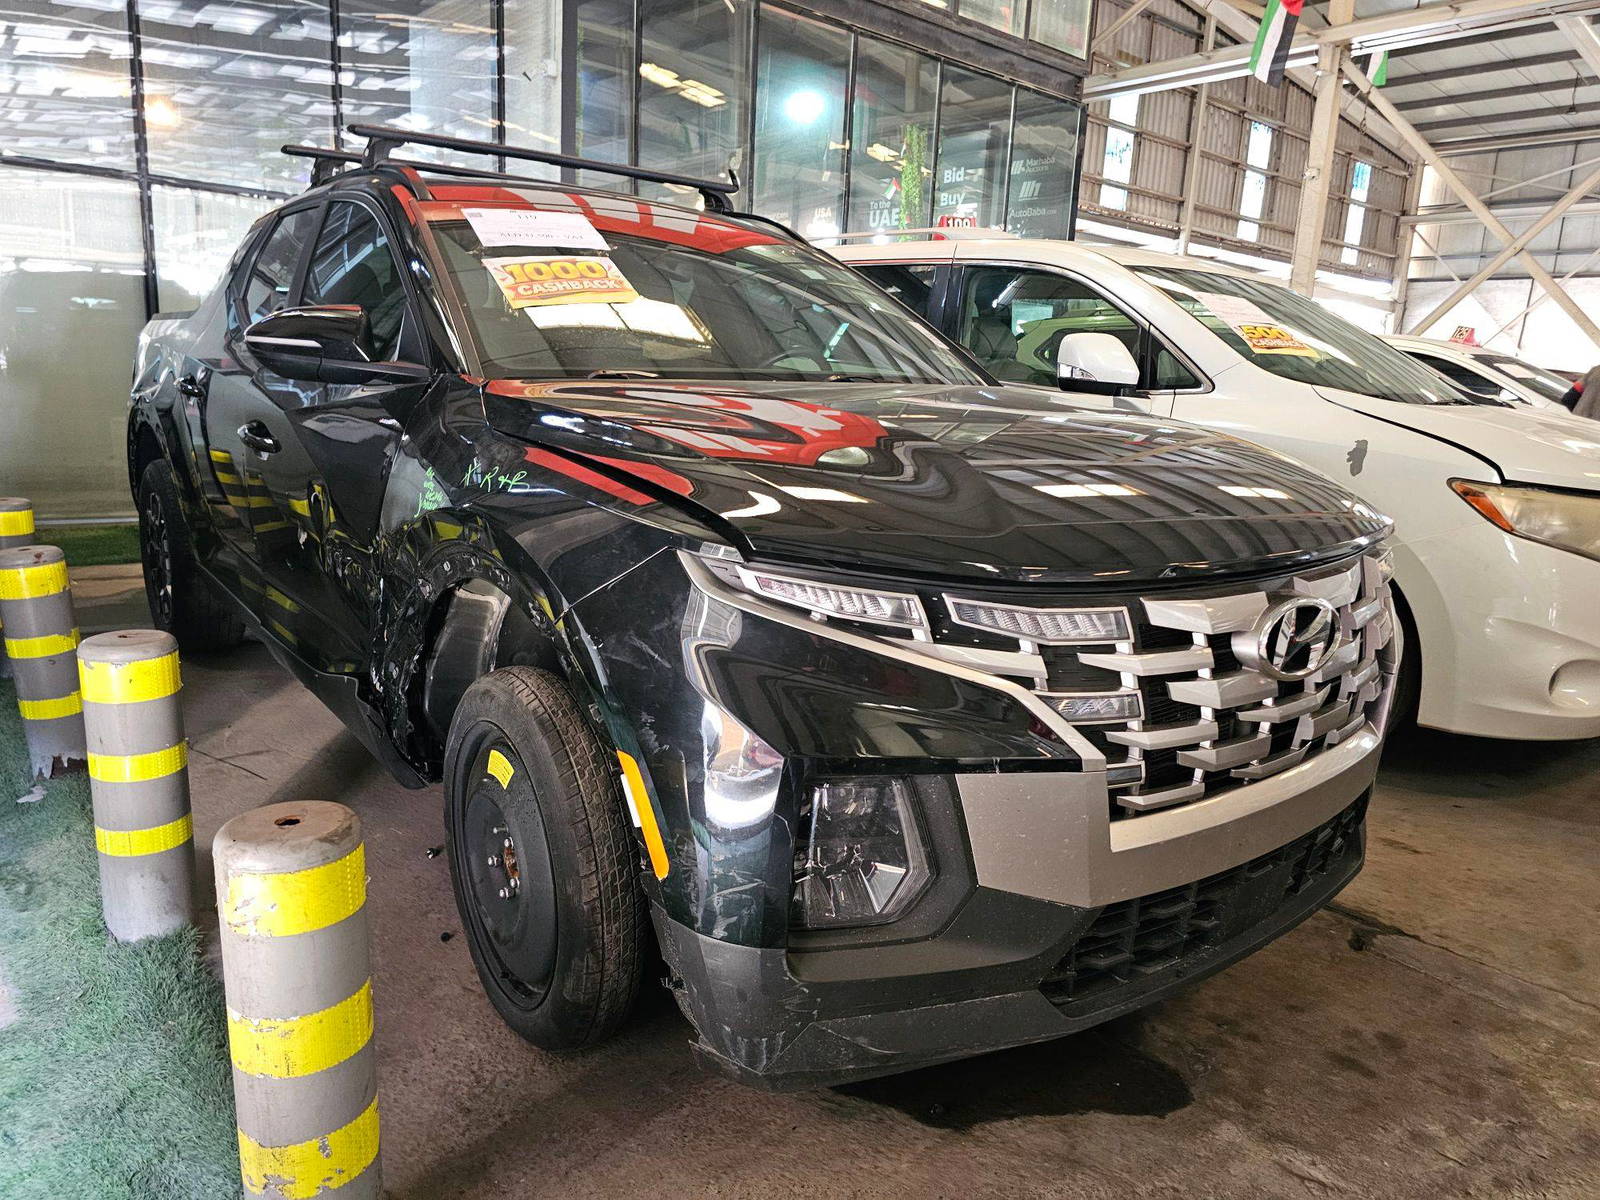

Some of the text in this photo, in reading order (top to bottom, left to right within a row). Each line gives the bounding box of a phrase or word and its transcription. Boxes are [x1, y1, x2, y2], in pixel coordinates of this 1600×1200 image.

[943, 167, 965, 184] Bid
[879, 200, 891, 209] the
[940, 192, 966, 208] Buy
[814, 207, 832, 218] USA
[869, 208, 900, 228] UAE
[503, 261, 608, 281] 1000
[517, 279, 619, 296] CASHBACK
[1241, 325, 1293, 341] 500
